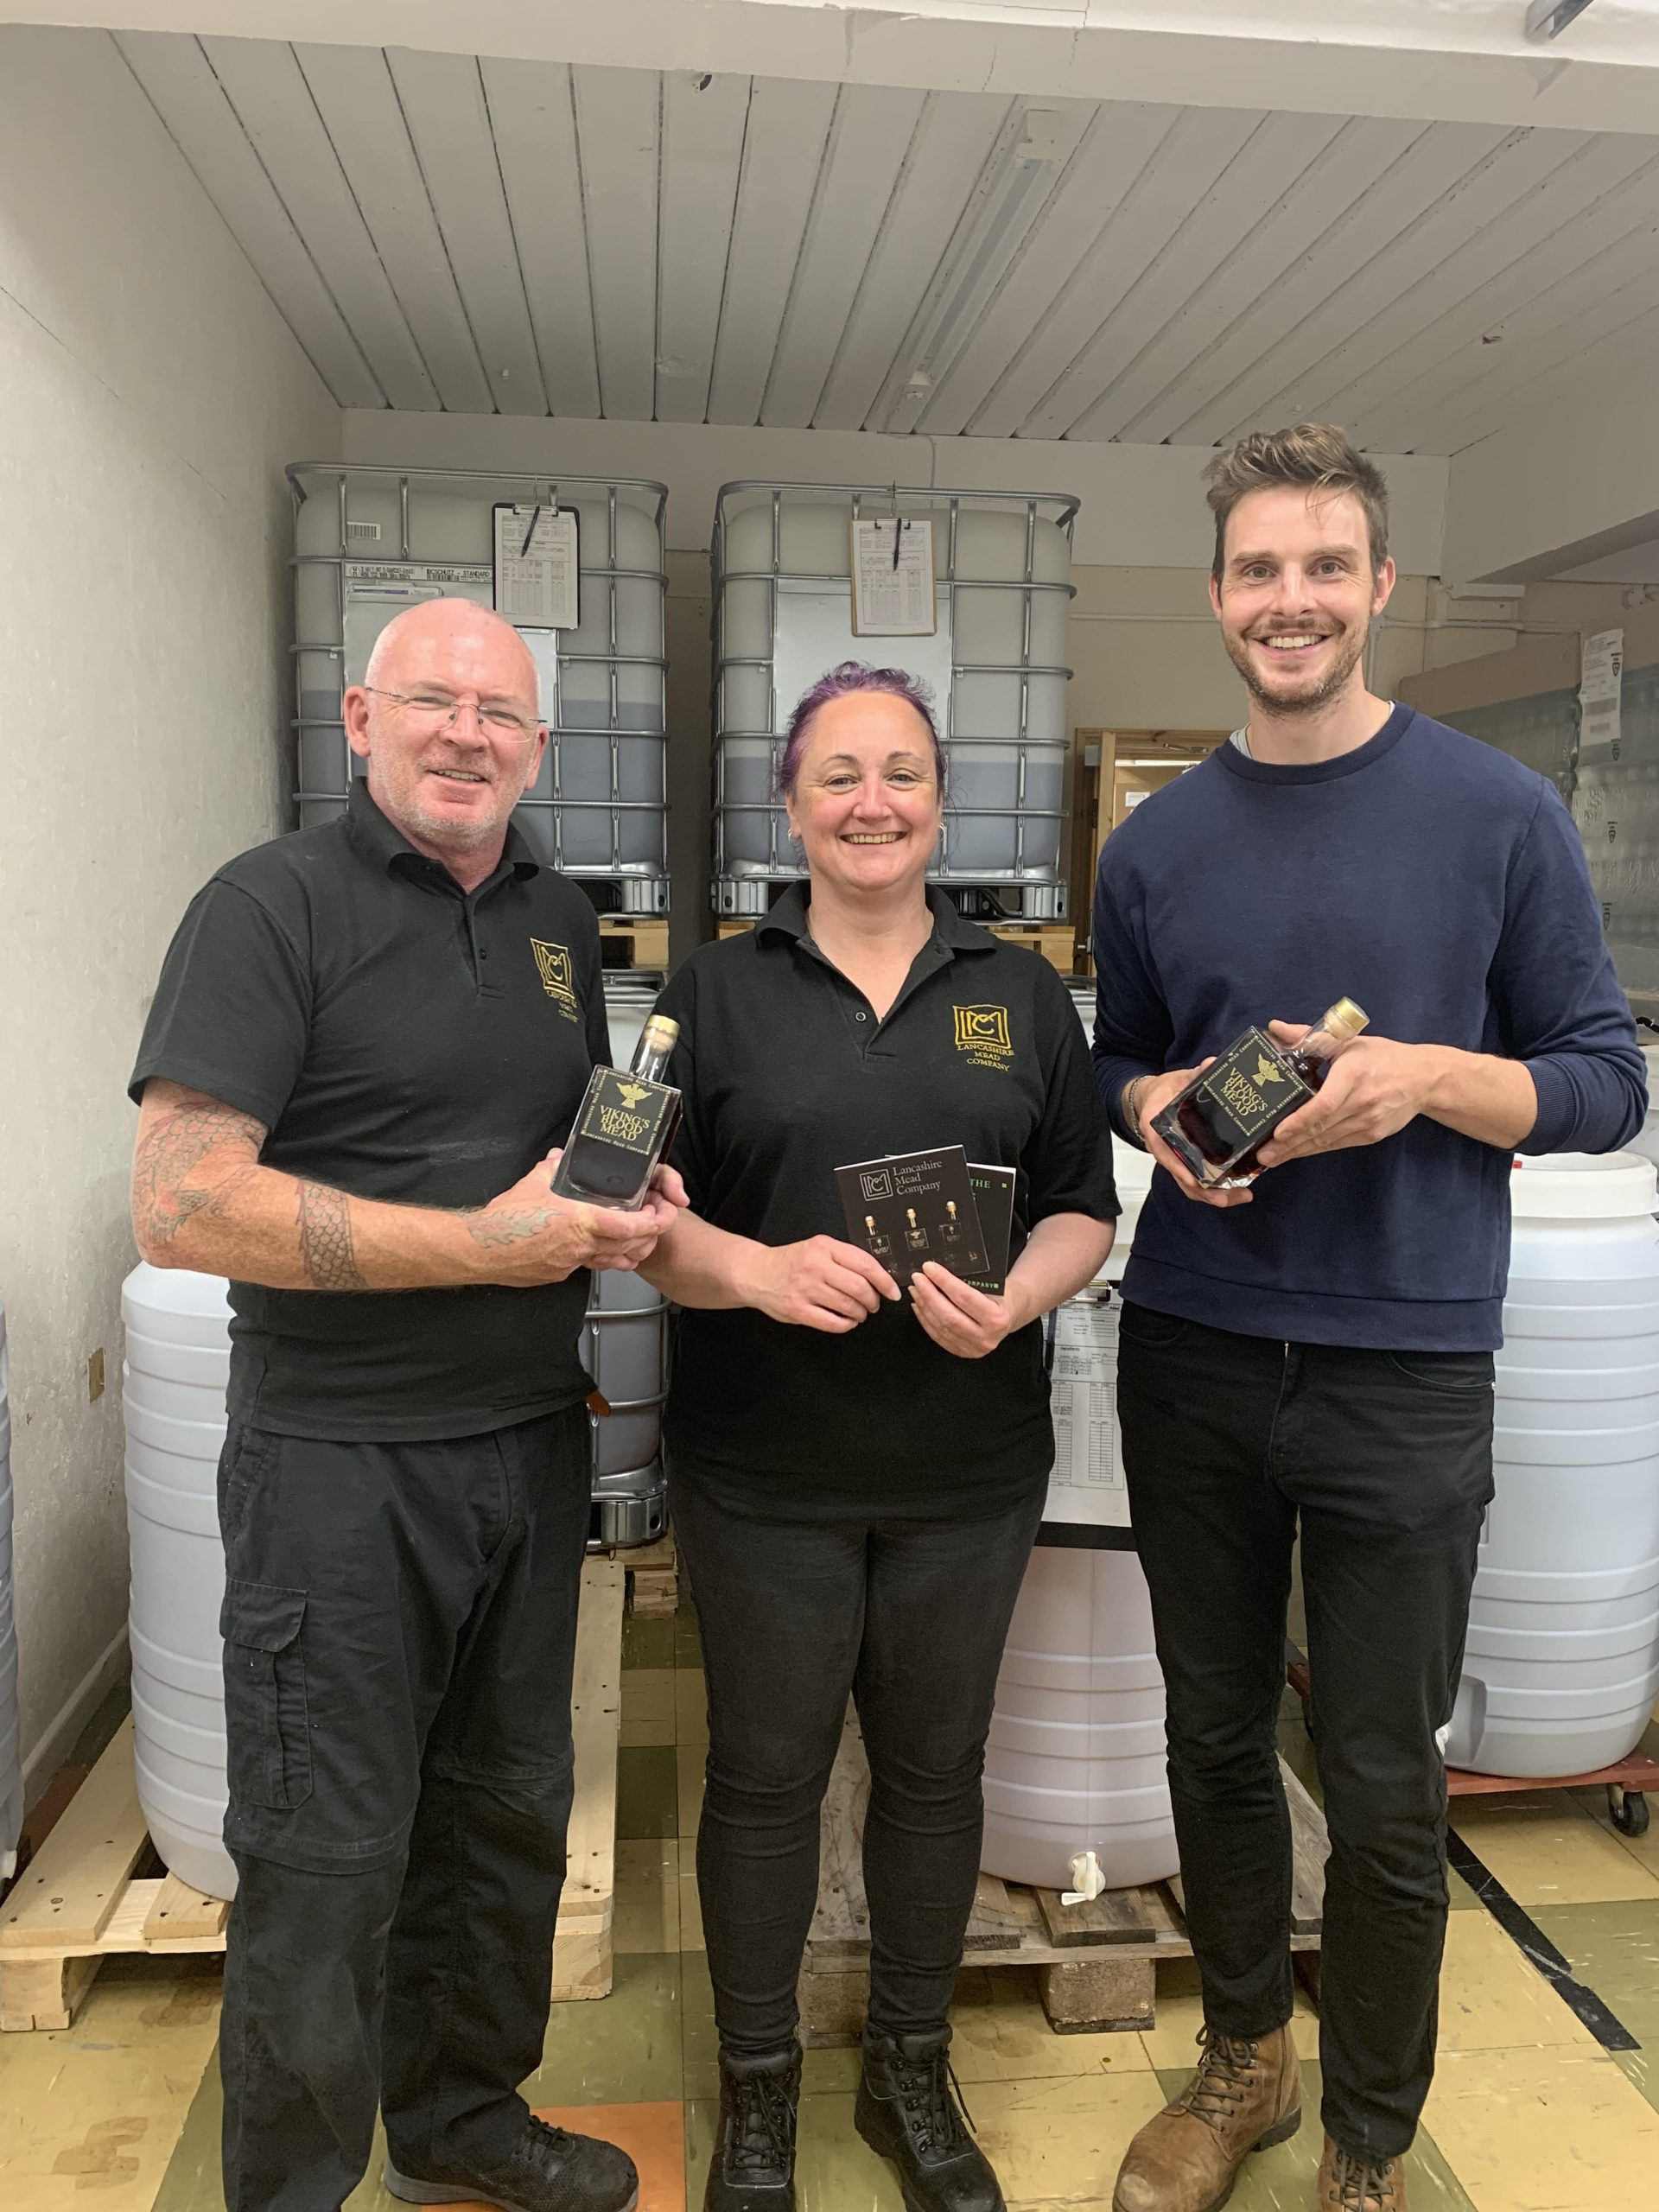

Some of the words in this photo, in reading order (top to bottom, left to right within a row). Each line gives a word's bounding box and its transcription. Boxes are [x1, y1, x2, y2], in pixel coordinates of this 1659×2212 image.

[957, 1044, 1014, 1056] LANCASHIRE
[974, 1051, 1001, 1061] MEAD
[967, 1058, 1010, 1071] COMPANY
[1225, 1077, 1258, 1113] BLOOD
[1230, 1067, 1268, 1111] VIKING'S
[1220, 1085, 1249, 1116] MEAD
[600, 1105, 650, 1128] VIKING'S
[601, 1115, 643, 1135] BLOOD
[601, 1124, 637, 1141] MEAD
[893, 1160, 943, 1176] Lancashire
[895, 1173, 922, 1185] Mead
[970, 1179, 991, 1188] THE
[896, 1180, 941, 1195] Company
